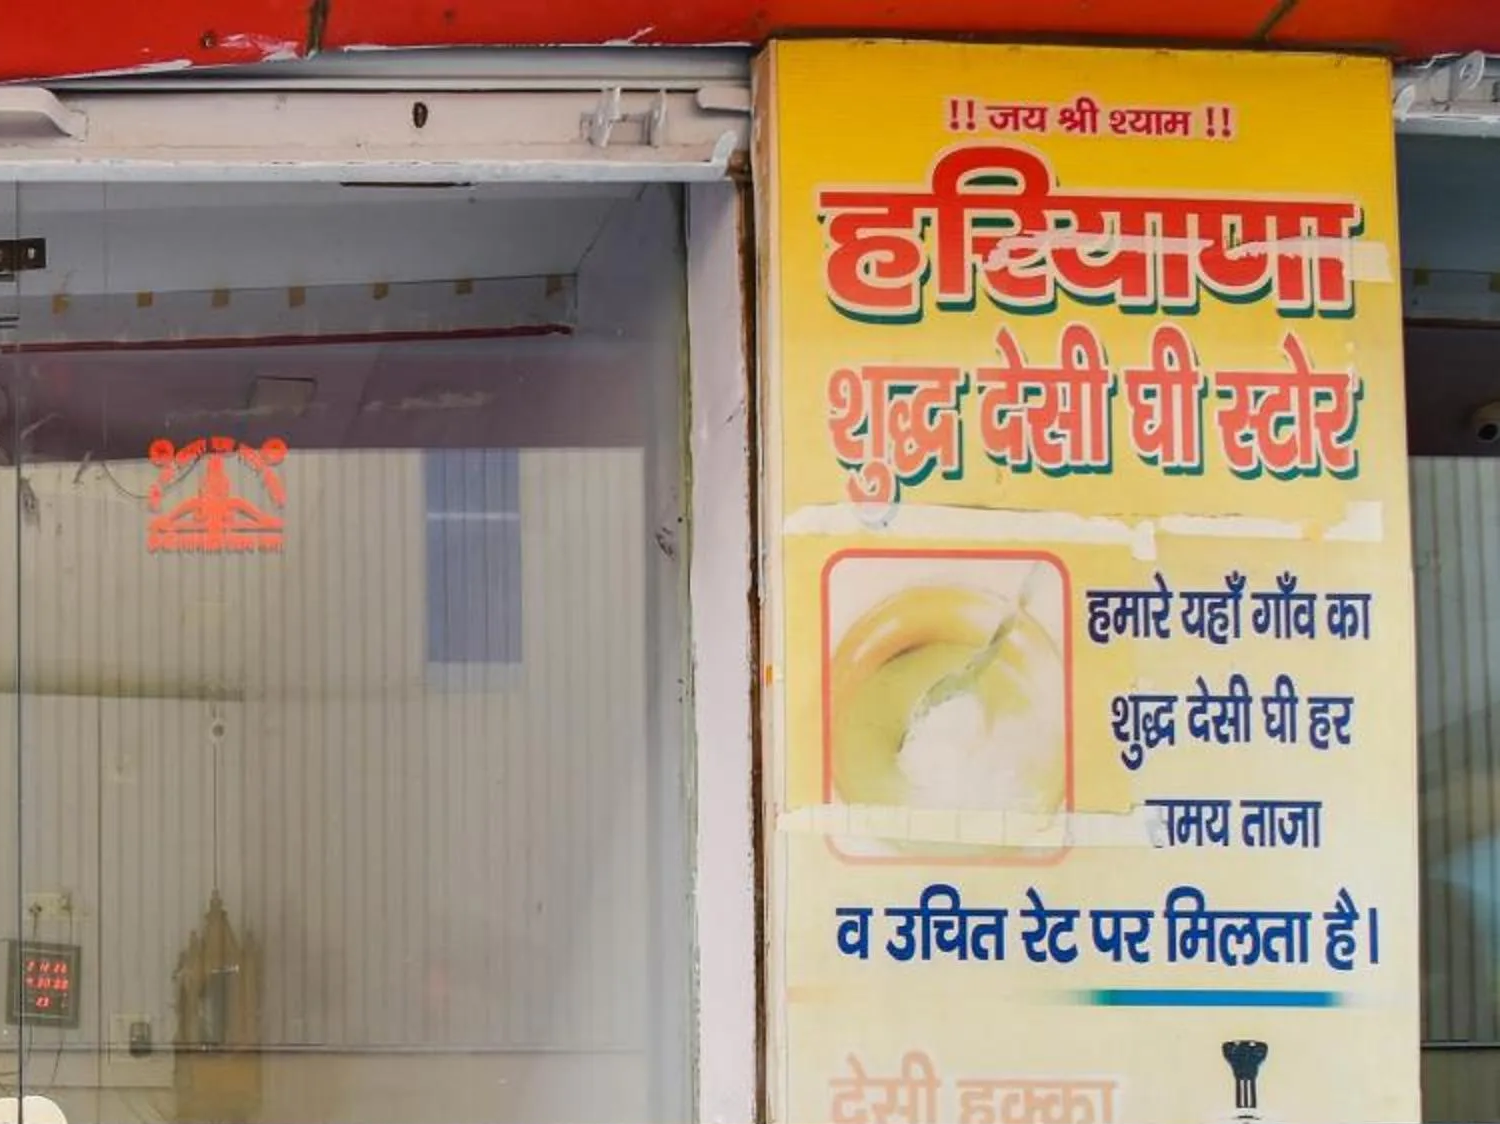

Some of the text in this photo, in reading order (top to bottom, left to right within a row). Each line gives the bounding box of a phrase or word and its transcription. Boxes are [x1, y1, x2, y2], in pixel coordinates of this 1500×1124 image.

[986, 102, 1047, 133] जय
[1058, 97, 1100, 135] श्री
[1108, 109, 1192, 137] श्याम
[817, 144, 1366, 324] हरियाणा
[828, 324, 1365, 508] शुद्ध देसी घी स्टोर
[1086, 571, 1372, 644] हमारे यहाँ गाँव का
[1111, 674, 1354, 770] शुद्ध देसी घी हर
[1240, 799, 1322, 849] ताजा
[836, 906, 873, 960] व
[885, 884, 1006, 962] उचित
[1020, 889, 1081, 963] रेट
[1091, 906, 1154, 963] पर
[1164, 886, 1312, 965] मिलता
